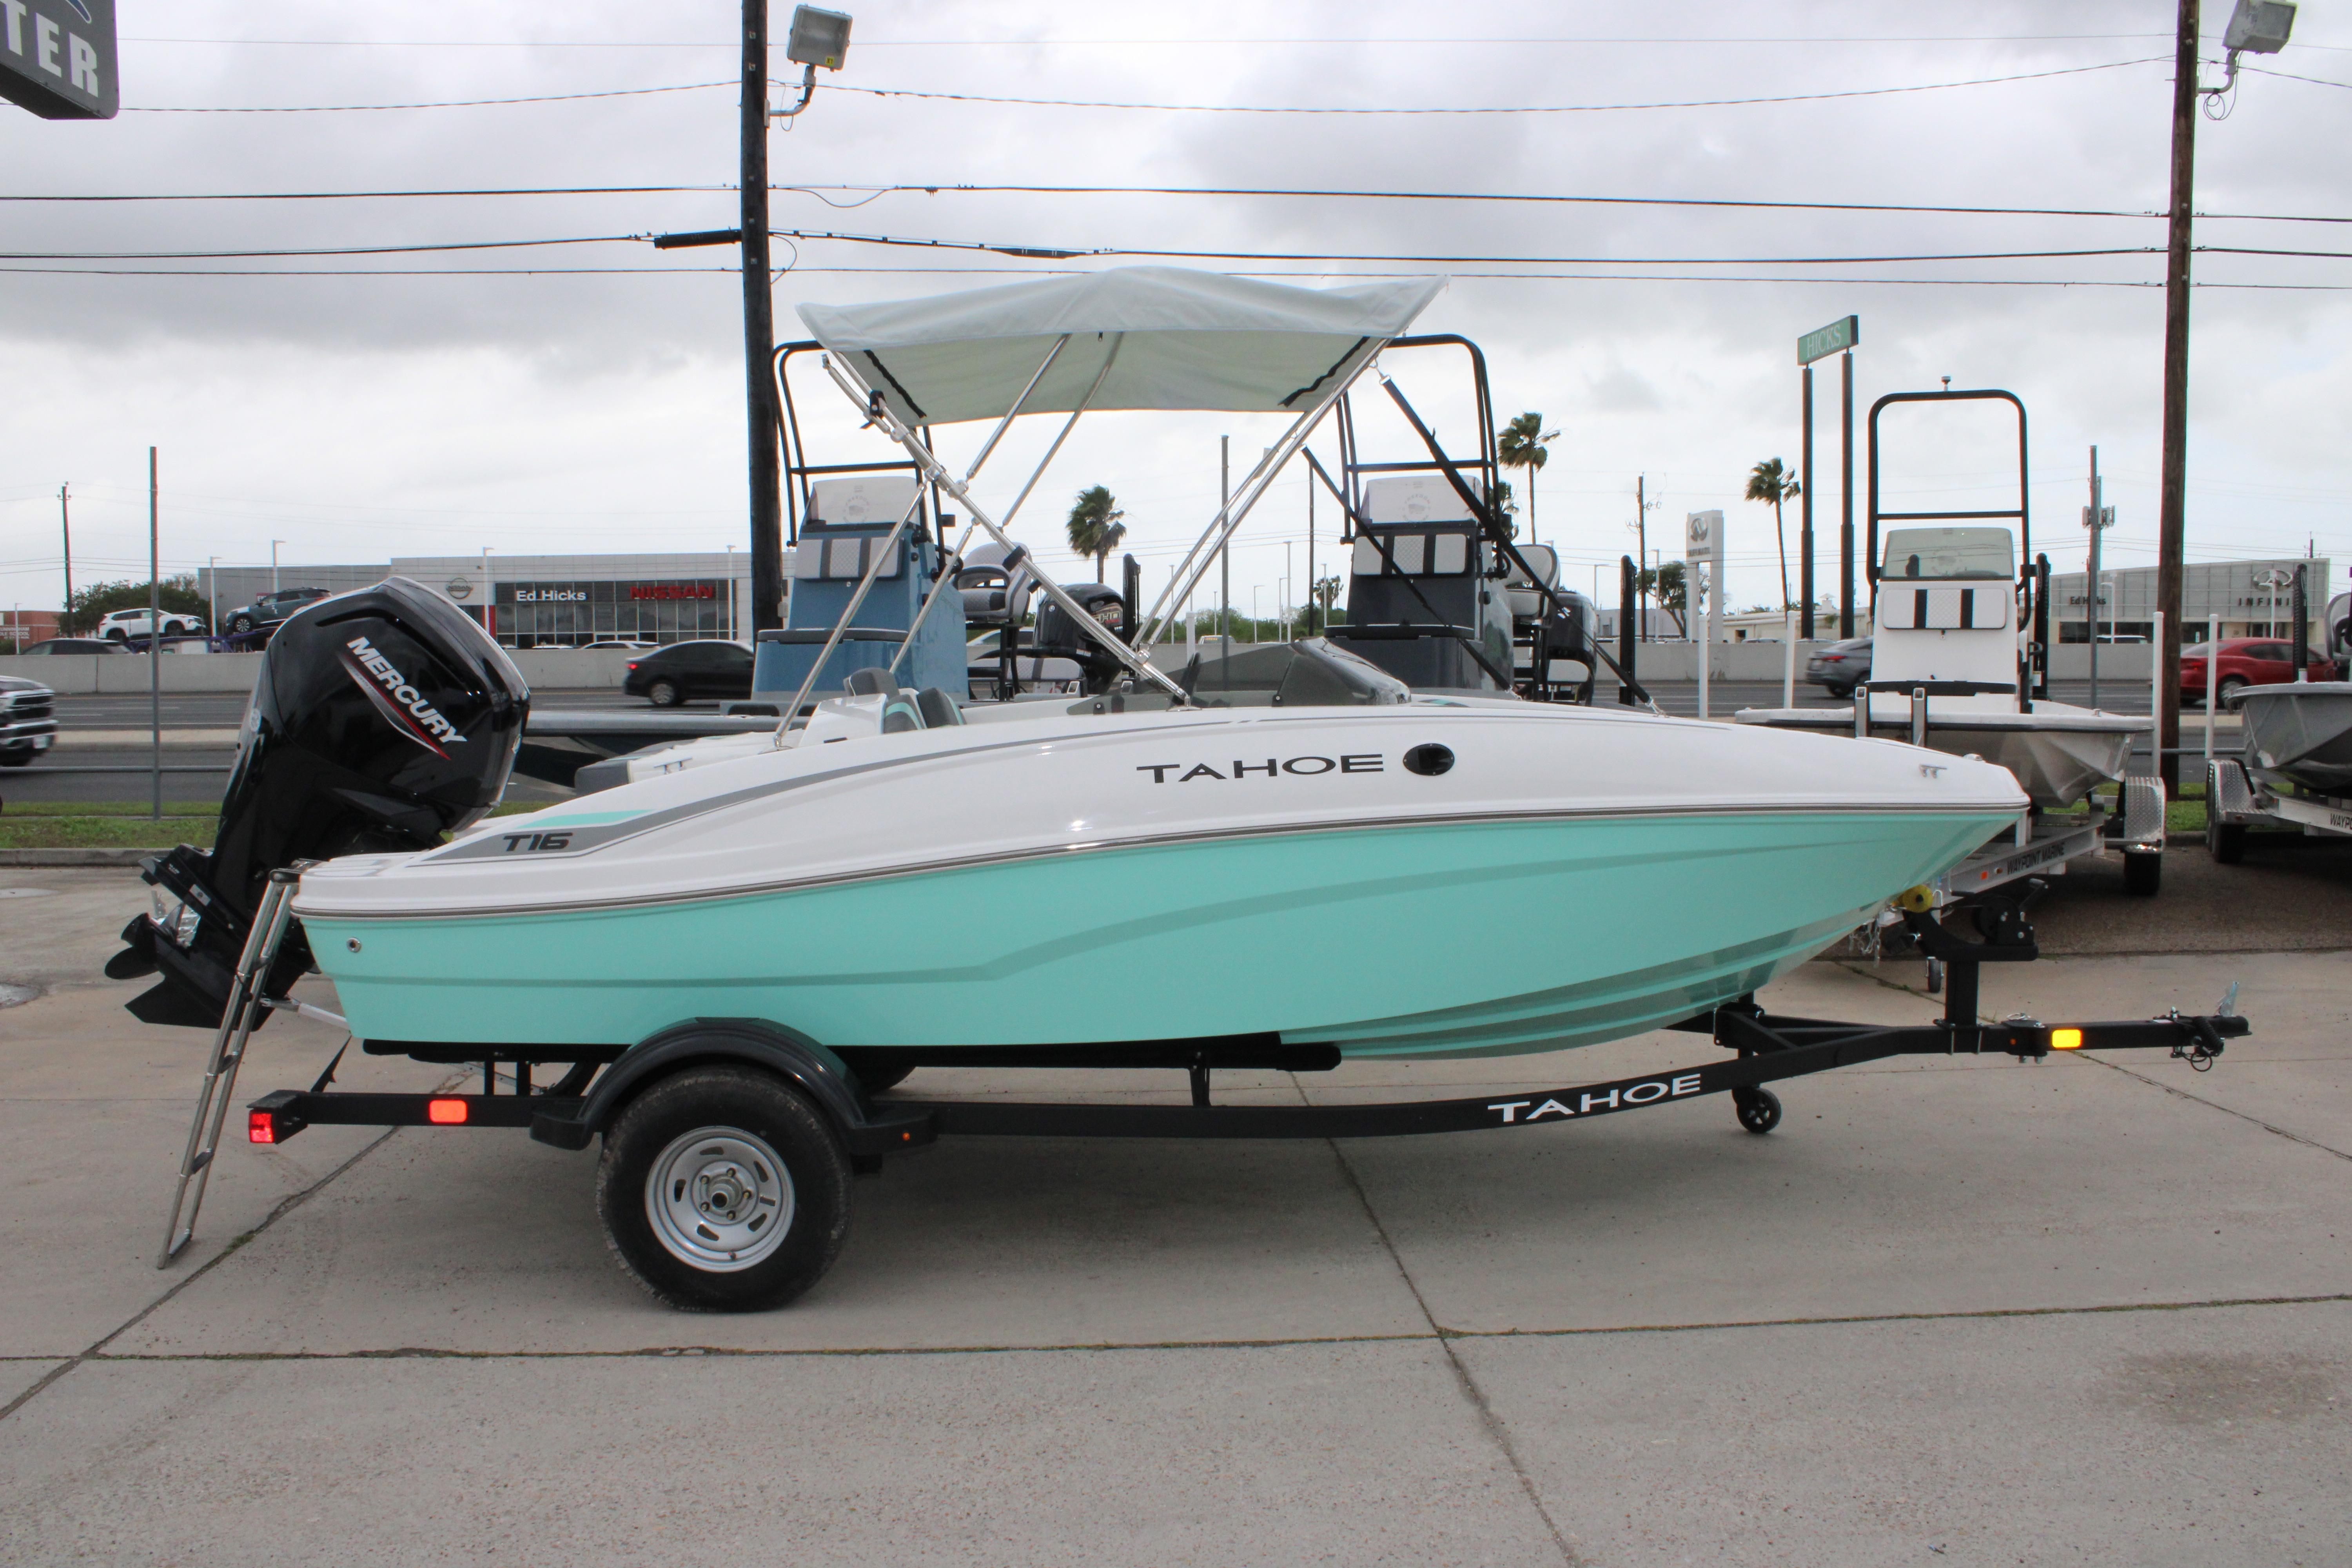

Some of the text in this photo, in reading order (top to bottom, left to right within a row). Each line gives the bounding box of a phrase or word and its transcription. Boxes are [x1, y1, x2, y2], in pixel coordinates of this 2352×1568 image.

[1806, 325, 1842, 358] HICKS
[516, 590, 587, 601] Ed Hicks
[630, 585, 713, 600] NISSAN
[2070, 596, 2106, 604] Ed Hks
[2238, 597, 2290, 606] INFINI
[347, 636, 468, 743] MERCURY
[1136, 754, 1384, 784] TAHOE
[504, 832, 573, 852] T16
[2007, 842, 2065, 875] WAYPOINT MARINE
[1487, 1073, 1701, 1122] TAHOE
